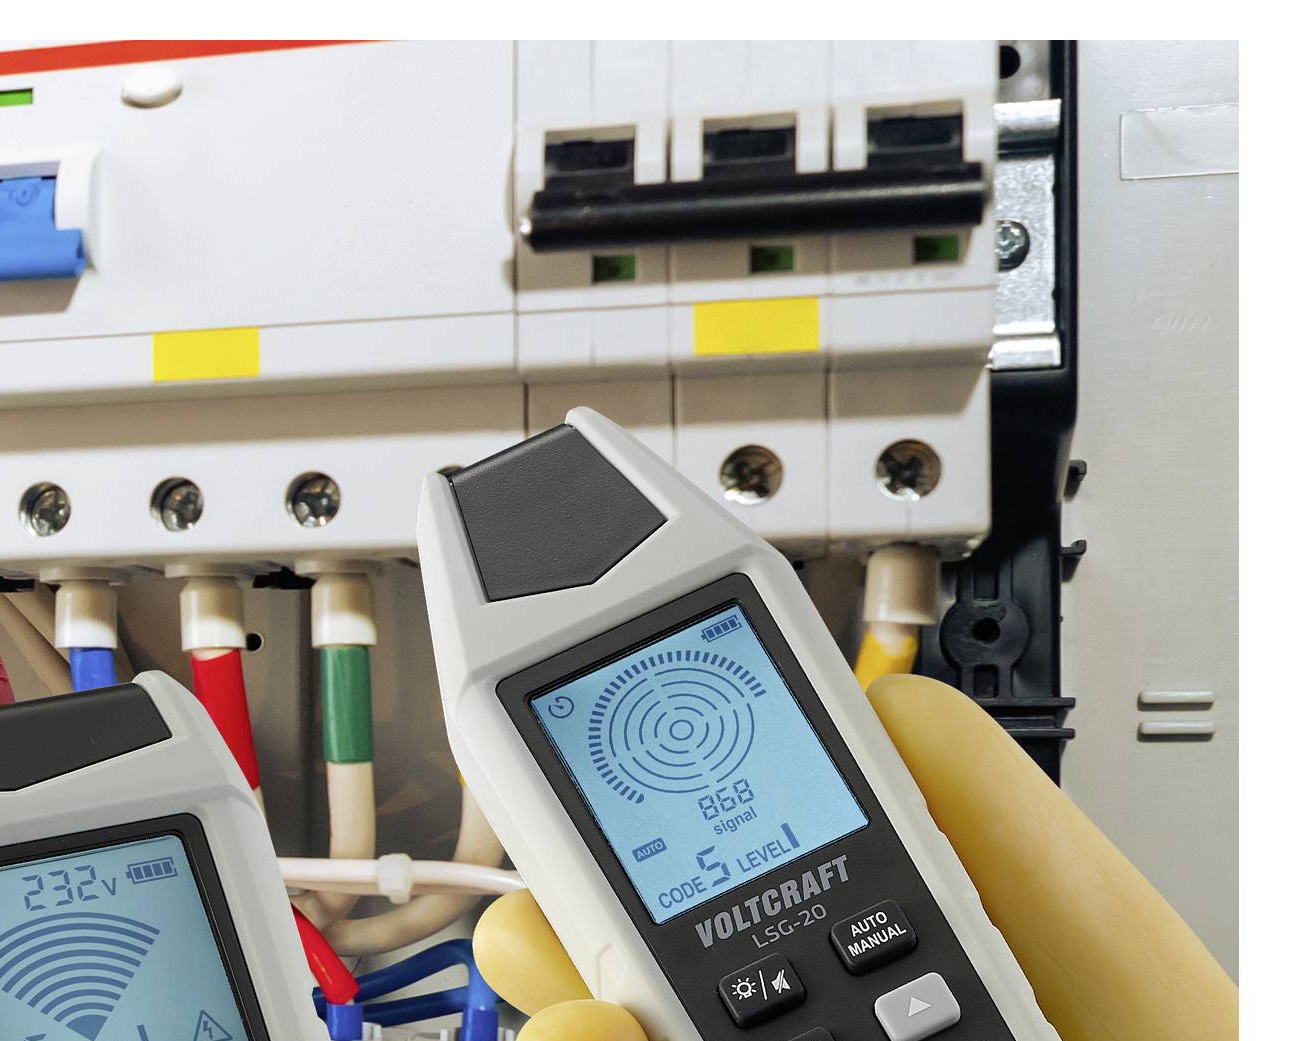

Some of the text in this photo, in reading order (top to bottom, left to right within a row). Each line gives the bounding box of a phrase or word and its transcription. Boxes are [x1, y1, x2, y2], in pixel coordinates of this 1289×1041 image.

[698, 778, 754, 820] 868
[713, 806, 757, 835] signal
[635, 841, 664, 860] AUTO
[658, 876, 707, 909] CODE
[696, 845, 731, 887] 5
[736, 839, 791, 873] LEVEL
[694, 854, 851, 949] VOLTCRAFT
[751, 903, 828, 950] LSG-20
[848, 922, 906, 957] MANUAL
[850, 911, 888, 938] AUTO
